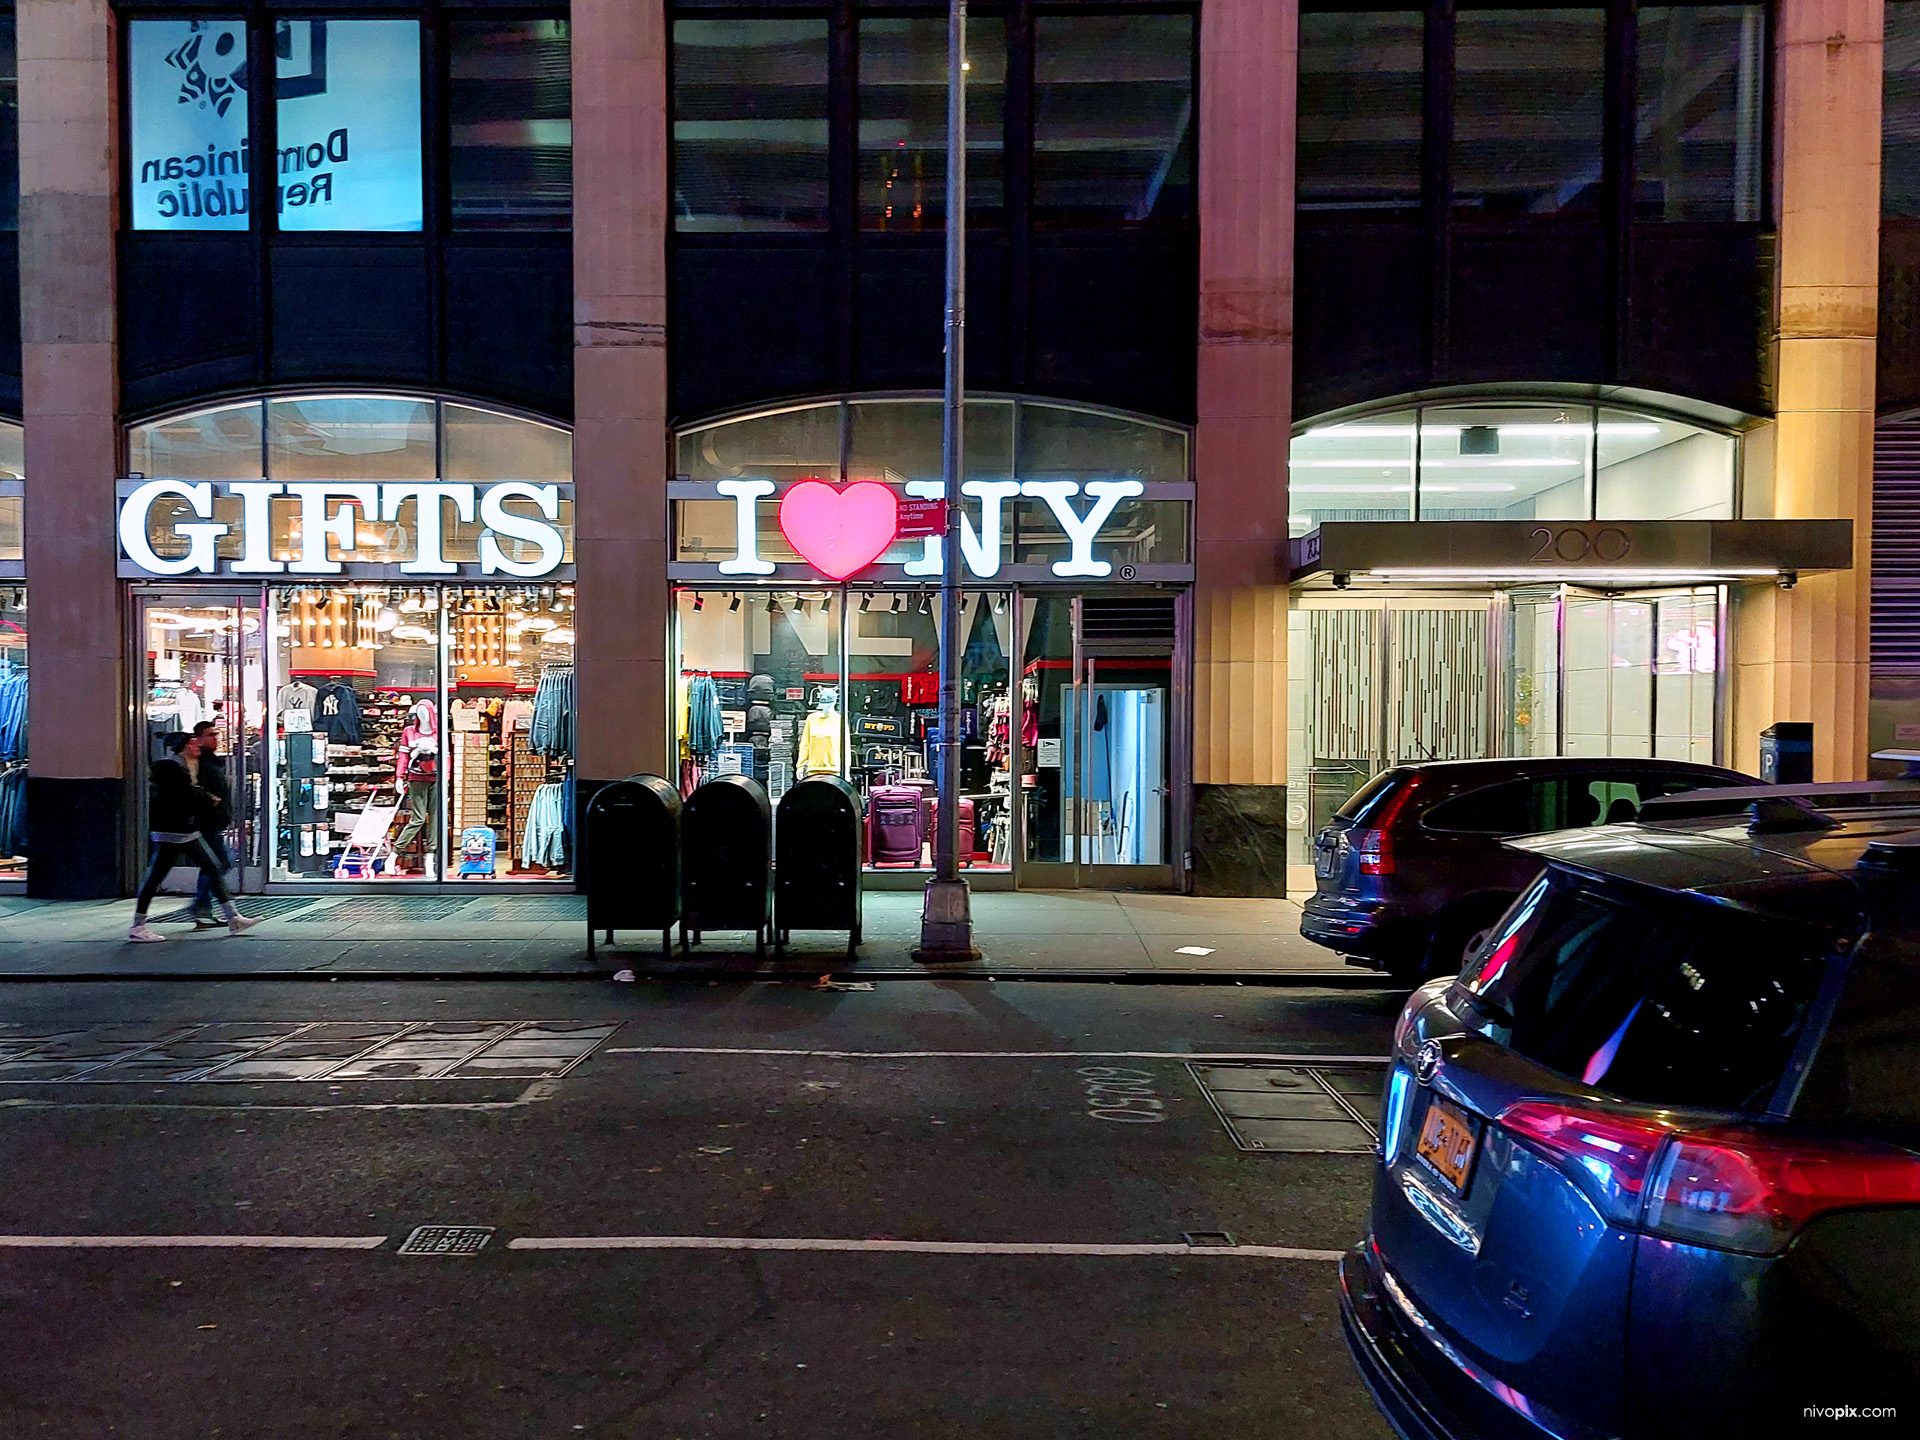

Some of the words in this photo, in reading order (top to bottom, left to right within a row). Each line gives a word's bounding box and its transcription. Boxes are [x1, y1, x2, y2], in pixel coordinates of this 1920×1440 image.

[899, 504, 908, 512] NO
[908, 502, 939, 512] STANDING
[899, 512, 924, 521] Anytime
[119, 479, 565, 577] GIFTS
[716, 480, 776, 576] I
[903, 480, 1144, 577] NY
[1528, 526, 1631, 562] 200
